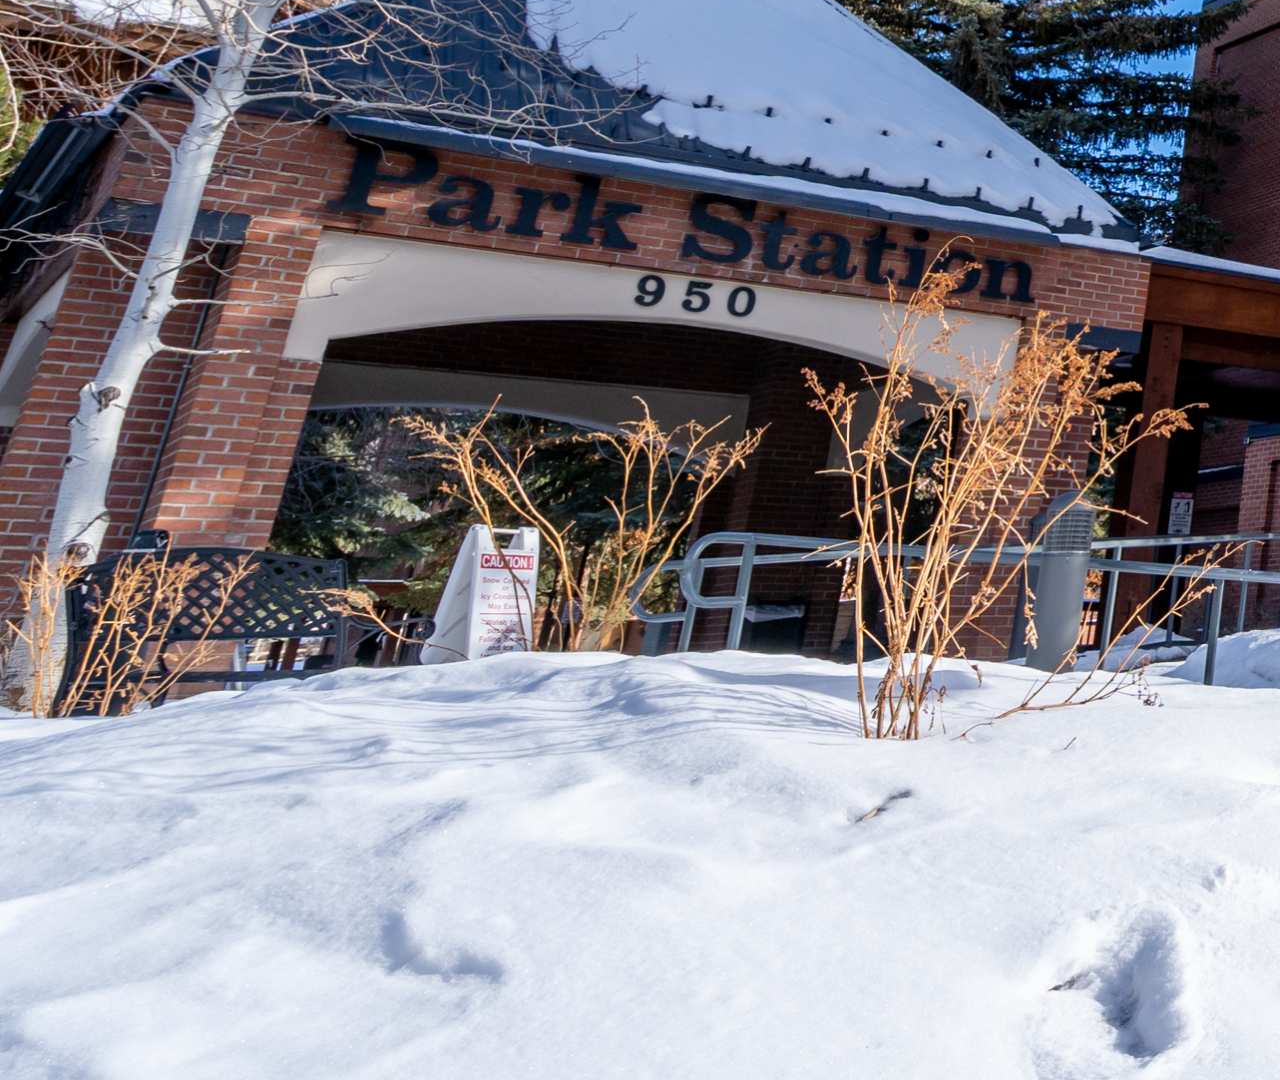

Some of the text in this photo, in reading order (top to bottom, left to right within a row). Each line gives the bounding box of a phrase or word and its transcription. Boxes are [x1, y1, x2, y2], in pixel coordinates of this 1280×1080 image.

[326, 134, 1034, 303] Park Station
[634, 274, 756, 317] 950
